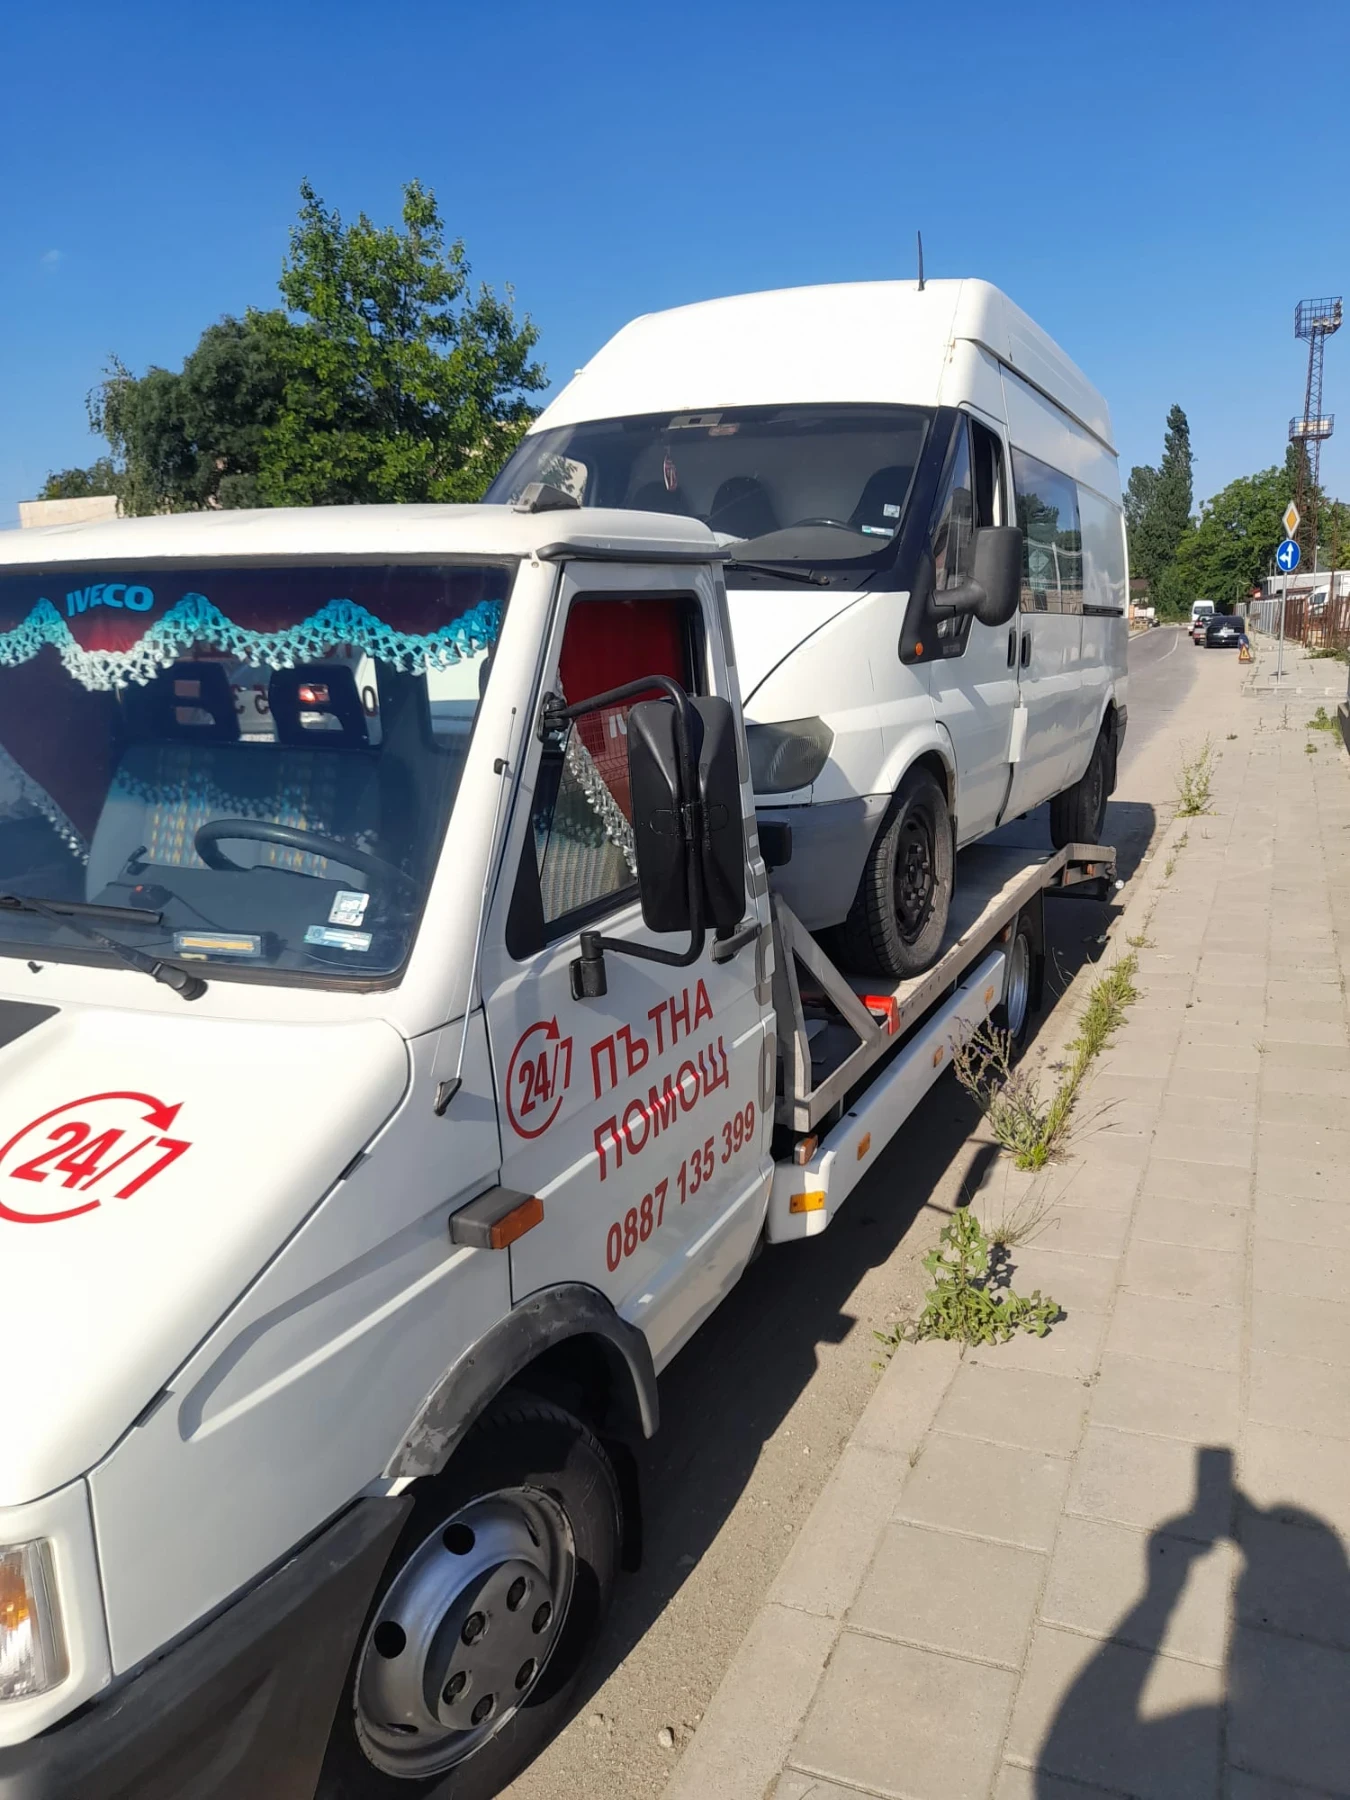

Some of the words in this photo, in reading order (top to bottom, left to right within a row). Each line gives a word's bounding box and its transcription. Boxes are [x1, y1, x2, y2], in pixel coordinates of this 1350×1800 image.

[66, 583, 154, 617] IVECO
[519, 1036, 573, 1117] 24/7
[590, 978, 714, 1101] ПЪТНА
[594, 1035, 729, 1182] ПОМОЩ
[9, 1121, 193, 1200] 24/7
[606, 1177, 669, 1272] 0887
[677, 1136, 715, 1205] 135
[721, 1101, 755, 1165] 399
